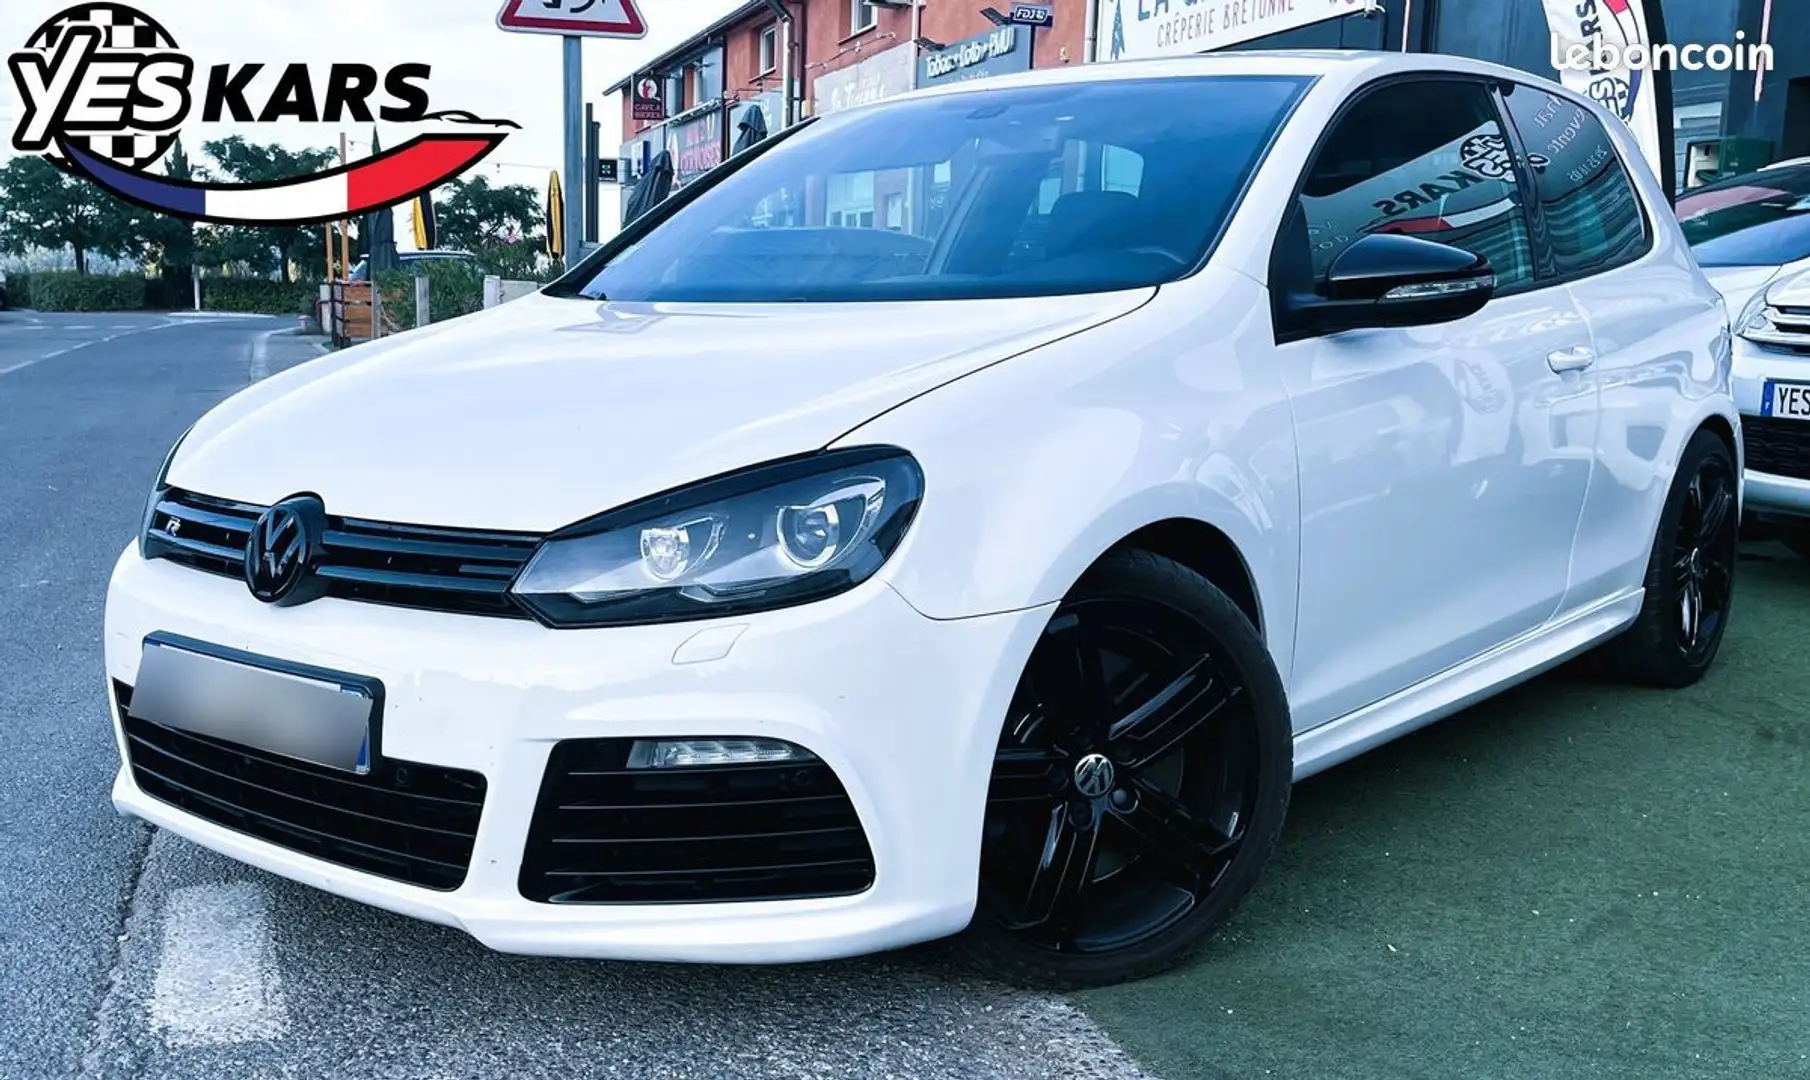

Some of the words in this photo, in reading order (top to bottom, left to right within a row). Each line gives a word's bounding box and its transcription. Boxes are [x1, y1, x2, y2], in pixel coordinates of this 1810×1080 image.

[1016, 8, 1036, 20] FDJ
[1156, 8, 1216, 48] CRÉPERIE
[165, 515, 181, 537] R
